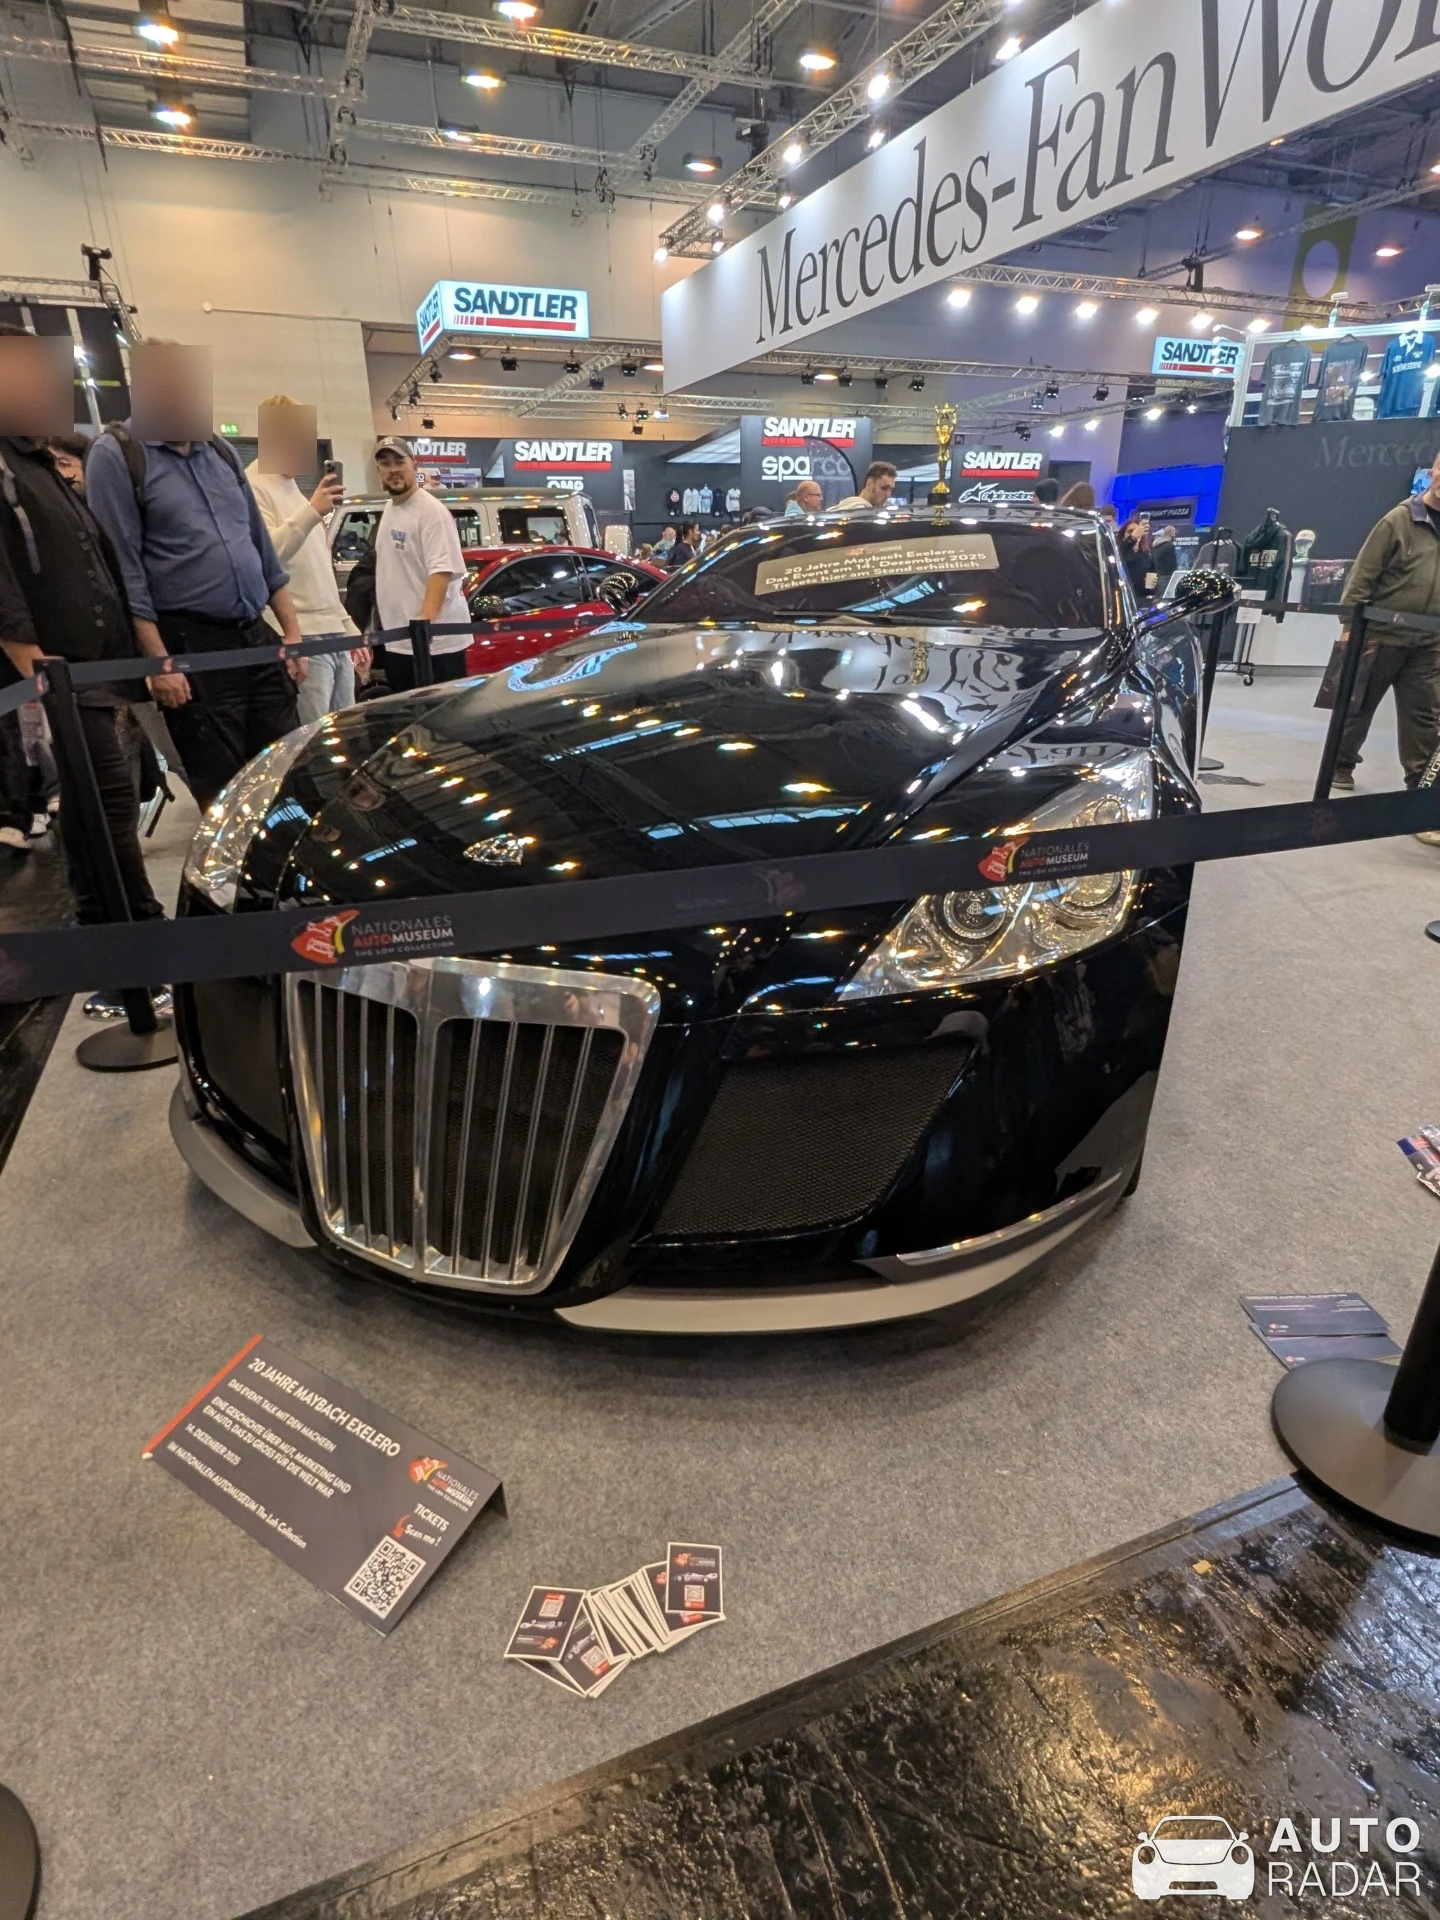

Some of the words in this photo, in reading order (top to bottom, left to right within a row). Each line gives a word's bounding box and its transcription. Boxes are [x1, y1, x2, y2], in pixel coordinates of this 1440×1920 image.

[454, 287, 579, 320] SANDTLER
[763, 417, 857, 438] SANDTLER
[514, 441, 613, 462] SANDTLER
[963, 451, 1042, 470] SANDTLER
[762, 455, 851, 482] sparco
[765, 576, 789, 585] Das
[792, 569, 829, 580] Event
[832, 566, 852, 574] am
[880, 556, 946, 568] Dezember
[949, 553, 987, 561] 2025
[773, 578, 818, 590] Tickets
[821, 574, 846, 582] hier
[849, 569, 870, 578] am
[874, 565, 912, 575] Stand
[916, 561, 980, 571] erhältlich
[784, 566, 803, 575] 20
[805, 561, 840, 572] Jahre
[844, 552, 902, 566] Maybach
[906, 549, 955, 558] Exelero
[1020, 853, 1088, 868] AUTOMUSEUM
[1021, 842, 1090, 858] NATIONALES
[351, 914, 453, 935] NATIONALES
[353, 928, 454, 947] AUTOMUSEUM
[354, 949, 373, 957] THE
[397, 941, 455, 953] COLLECTION
[228, 1378, 244, 1392] DAS
[261, 1399, 280, 1415] TALK
[275, 1409, 290, 1422] MIT
[286, 1416, 304, 1431] DEN
[300, 1425, 337, 1454] MACHERN
[247, 1358, 266, 1373] 20
[260, 1366, 299, 1394] JAHRE
[293, 1385, 351, 1426] MAYBACH
[346, 1417, 401, 1457] EXELERO
[185, 1423, 196, 1434] 14.
[193, 1428, 228, 1457] DEZEMBER
[223, 1450, 241, 1466] 2025
[202, 1405, 217, 1417] EIN
[213, 1412, 233, 1431] AUTO,
[231, 1423, 248, 1438] DAS
[243, 1431, 255, 1443] ZU
[252, 1439, 276, 1459] GROSS
[273, 1452, 290, 1468] FÜR
[286, 1461, 302, 1476] DIE
[298, 1471, 319, 1488] WELT
[316, 1482, 335, 1499] WAR
[211, 1396, 229, 1411] EINE
[225, 1405, 266, 1436] GESCHICHTE
[262, 1428, 282, 1447] ÜBER
[280, 1441, 297, 1459] MUT,
[294, 1452, 336, 1483] MARKETING
[332, 1477, 352, 1494] UND
[166, 1440, 180, 1453] IM
[175, 1447, 216, 1480] NATIONALEN
[211, 1475, 259, 1511] AUTOMUSEUM
[256, 1505, 268, 1520] The
[265, 1514, 280, 1528] Loh
[277, 1522, 307, 1549] Collection
[431, 1477, 474, 1507] AUTOMUSEUM
[436, 1470, 479, 1501] NATIONALES
[404, 1523, 423, 1539] Scan
[413, 1502, 450, 1532] TICKETS
